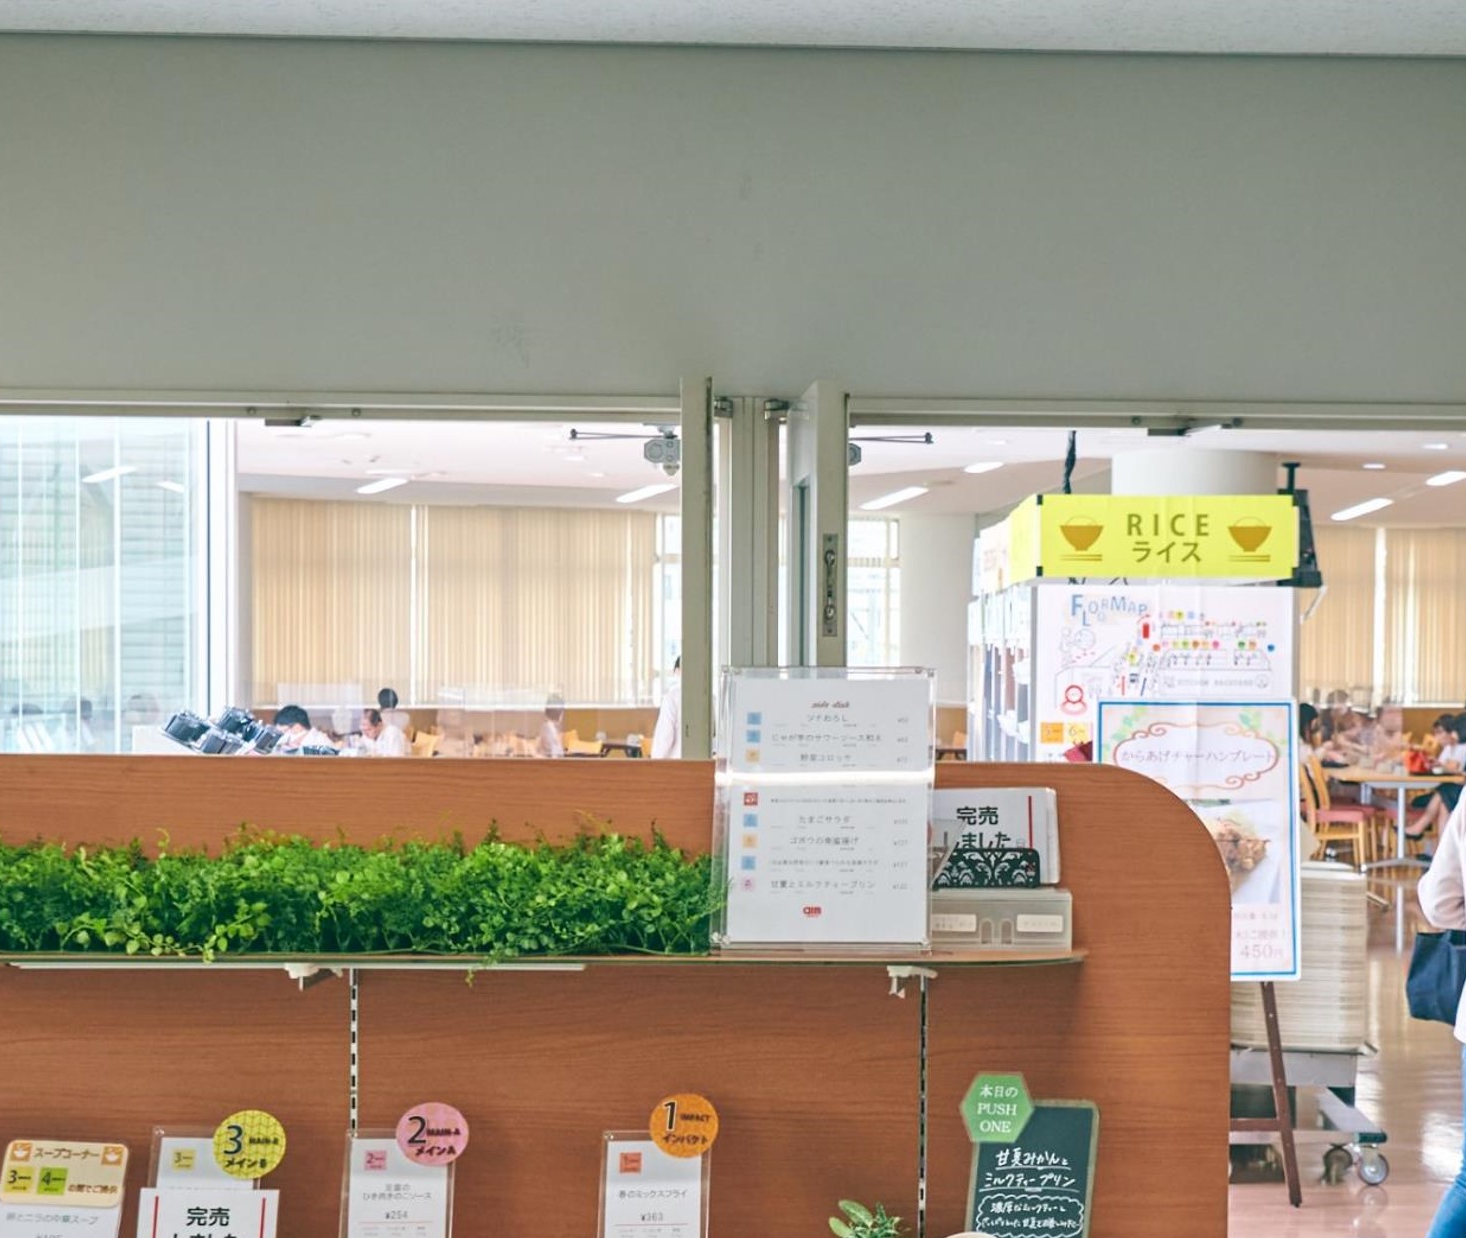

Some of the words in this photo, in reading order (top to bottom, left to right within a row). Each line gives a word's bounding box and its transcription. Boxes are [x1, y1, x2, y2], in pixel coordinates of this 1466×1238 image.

[1126, 513, 1210, 537] RICE
[1132, 541, 1202, 563] ライス
[956, 805, 1000, 826] 完売
[980, 1084, 1019, 1099] 本日の
[664, 1100, 677, 1131] 1
[679, 1113, 711, 1123] IMPACT
[976, 1102, 1018, 1117] PUSH
[407, 1114, 427, 1145] 2
[979, 1120, 1012, 1134] ONE
[223, 1124, 244, 1156] 3
[662, 1133, 709, 1146] インパクト
[33, 1147, 100, 1160] スープコーナー
[994, 1146, 1069, 1167] 甘夏みかんと
[7, 1169, 18, 1184] 3
[185, 1206, 231, 1227] 完売
